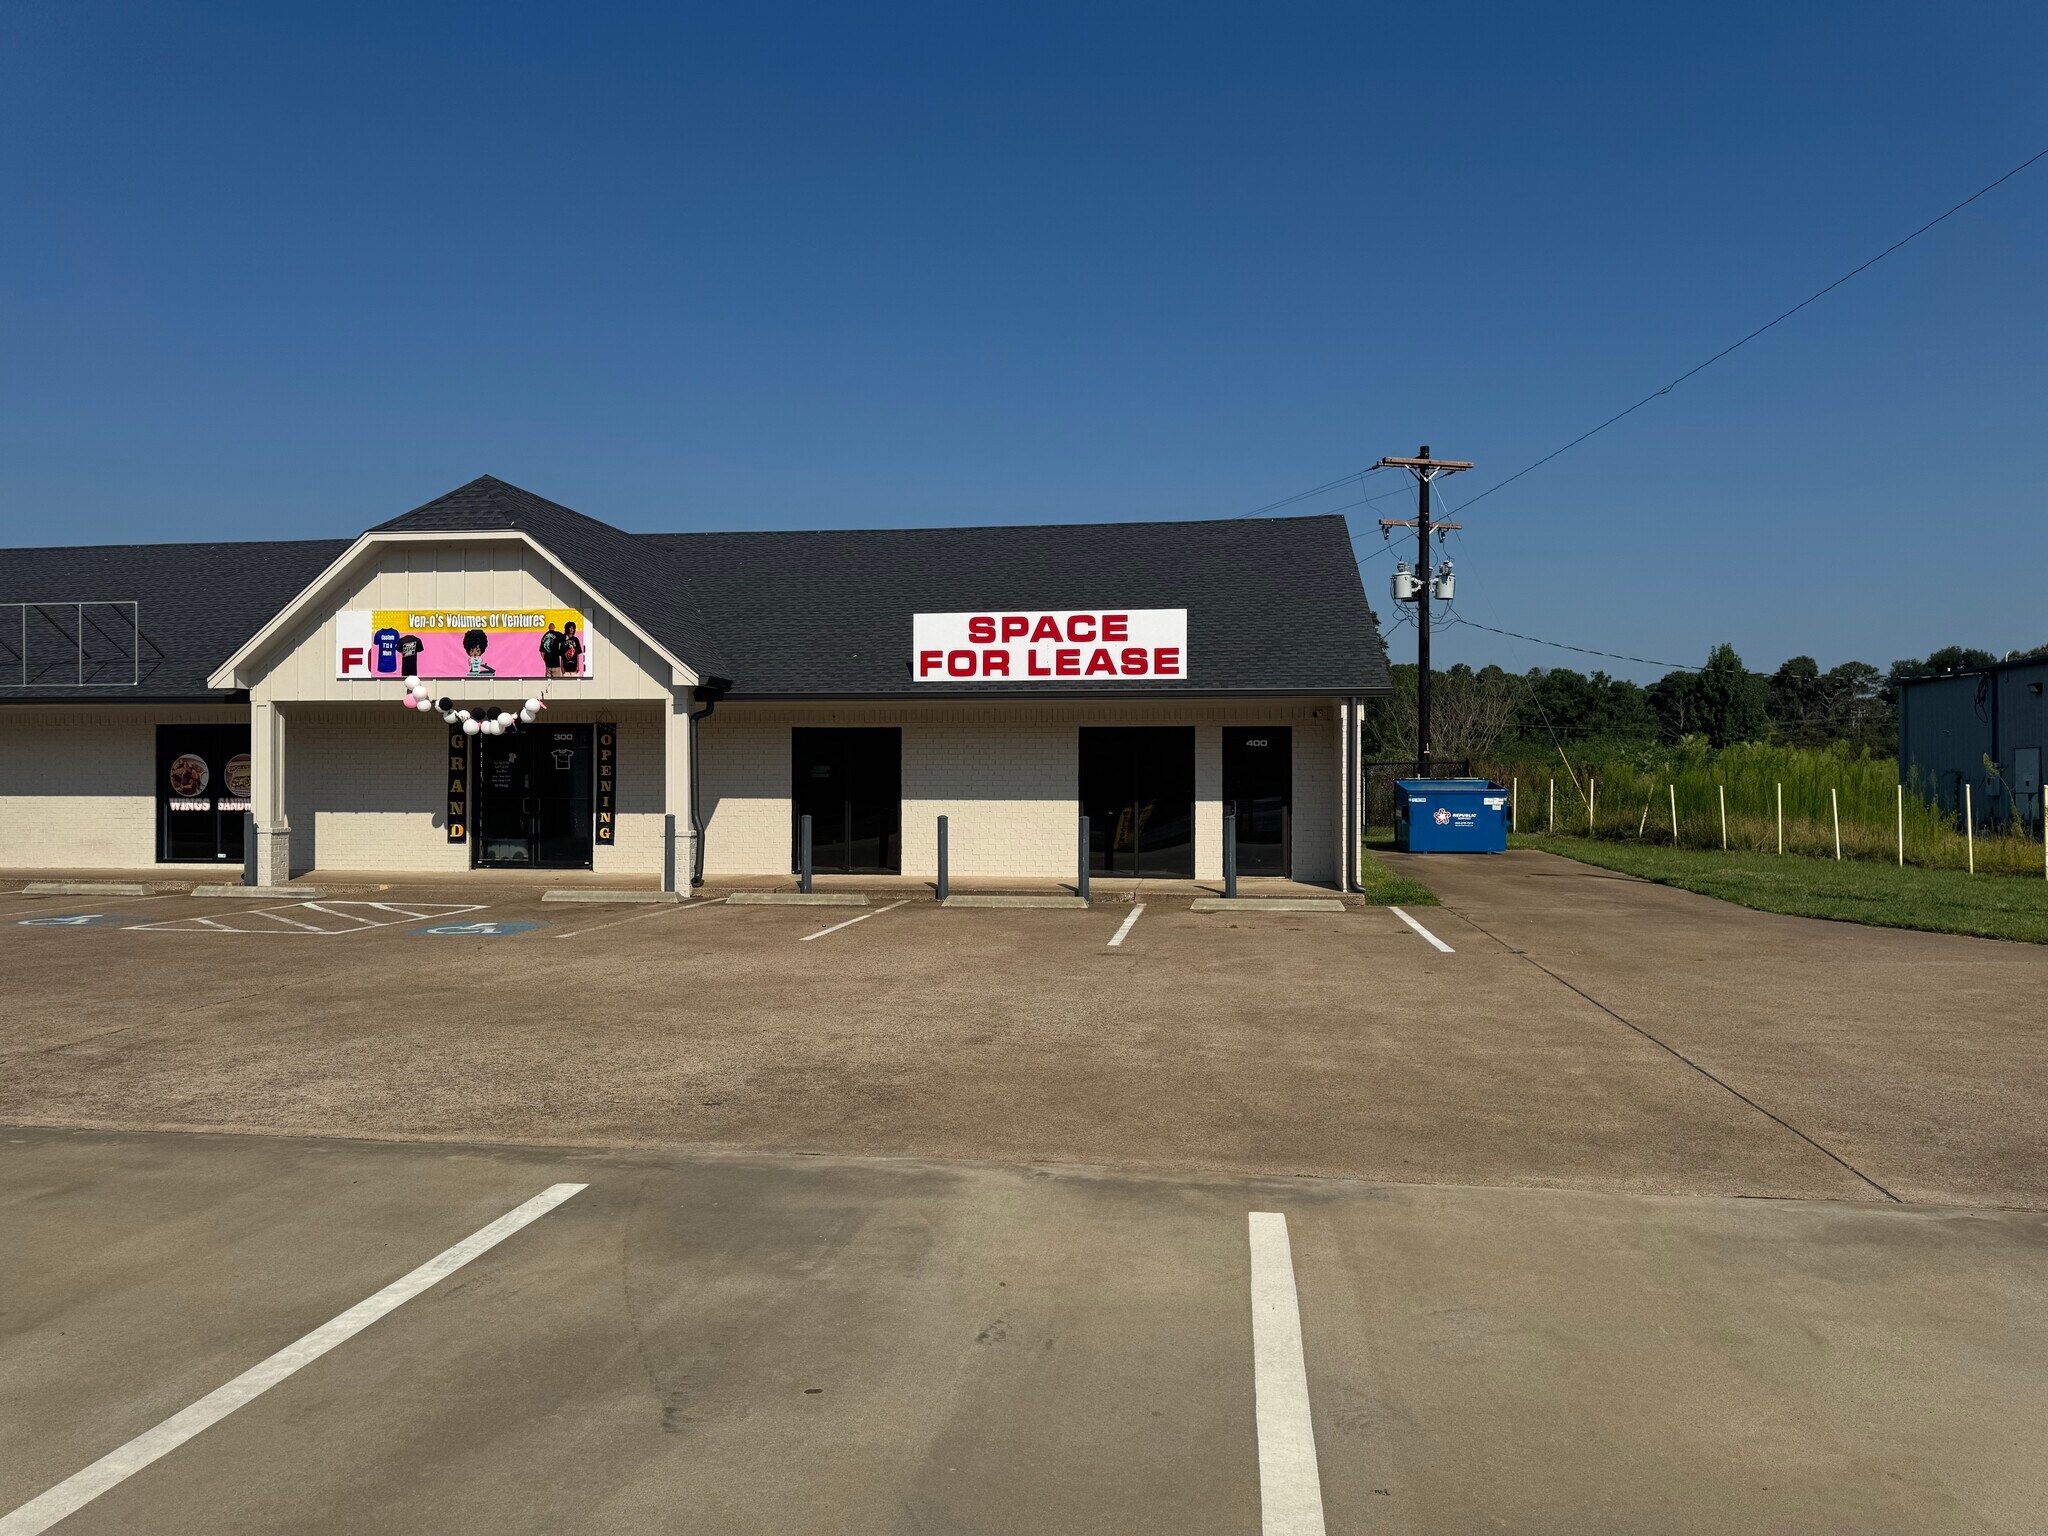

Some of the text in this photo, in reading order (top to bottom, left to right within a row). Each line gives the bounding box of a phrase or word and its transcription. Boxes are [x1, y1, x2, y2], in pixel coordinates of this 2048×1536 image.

[409, 614, 545, 628] Ven-o's Volumes Of Ventures
[968, 615, 1128, 643] SPACE
[920, 647, 1180, 677] FOR LEASE
[554, 733, 573, 741] 300
[1246, 739, 1268, 747] 400
[450, 734, 465, 838] GRAND
[599, 734, 613, 839] OPENING
[169, 797, 211, 811] WINGS
